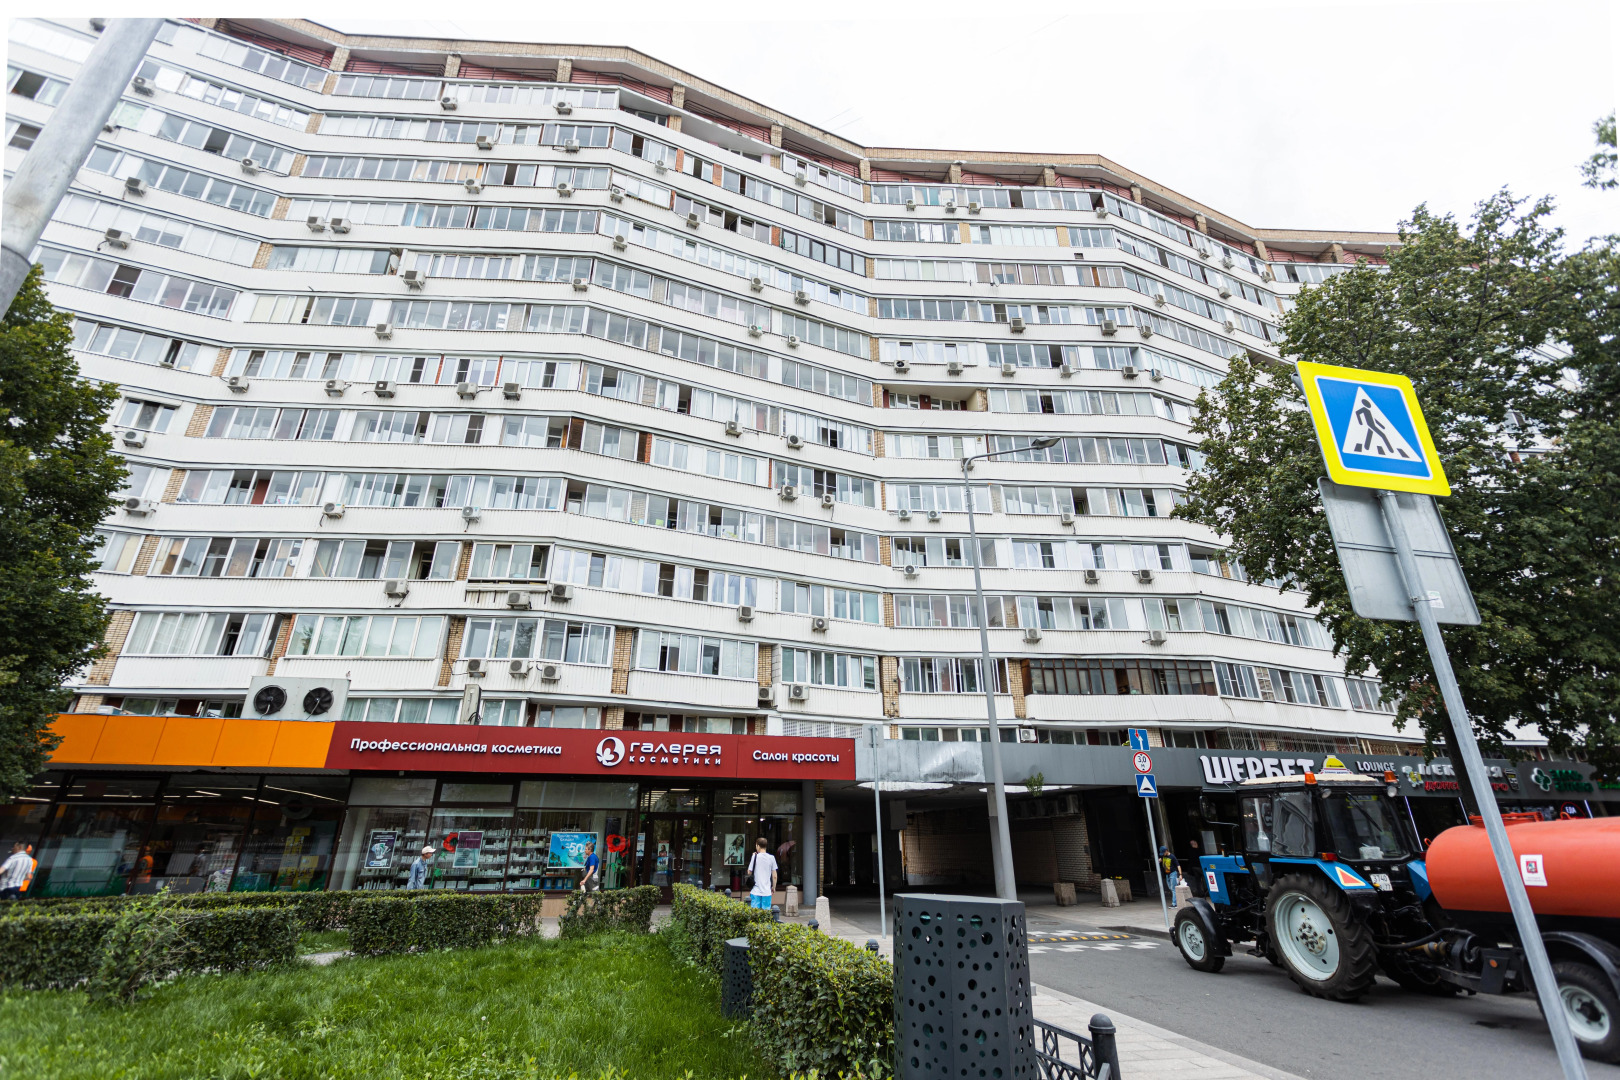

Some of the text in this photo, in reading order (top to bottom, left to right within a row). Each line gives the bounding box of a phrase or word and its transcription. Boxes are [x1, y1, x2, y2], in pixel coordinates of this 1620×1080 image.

[350, 737, 562, 755] Профессиональная косметика
[629, 754, 721, 765] косметики
[752, 749, 840, 764] Салон красоты
[1200, 755, 1315, 784] ШЕРБЕТ
[1356, 761, 1397, 772] LOUNGE
[1373, 874, 1388, 882] 3740
